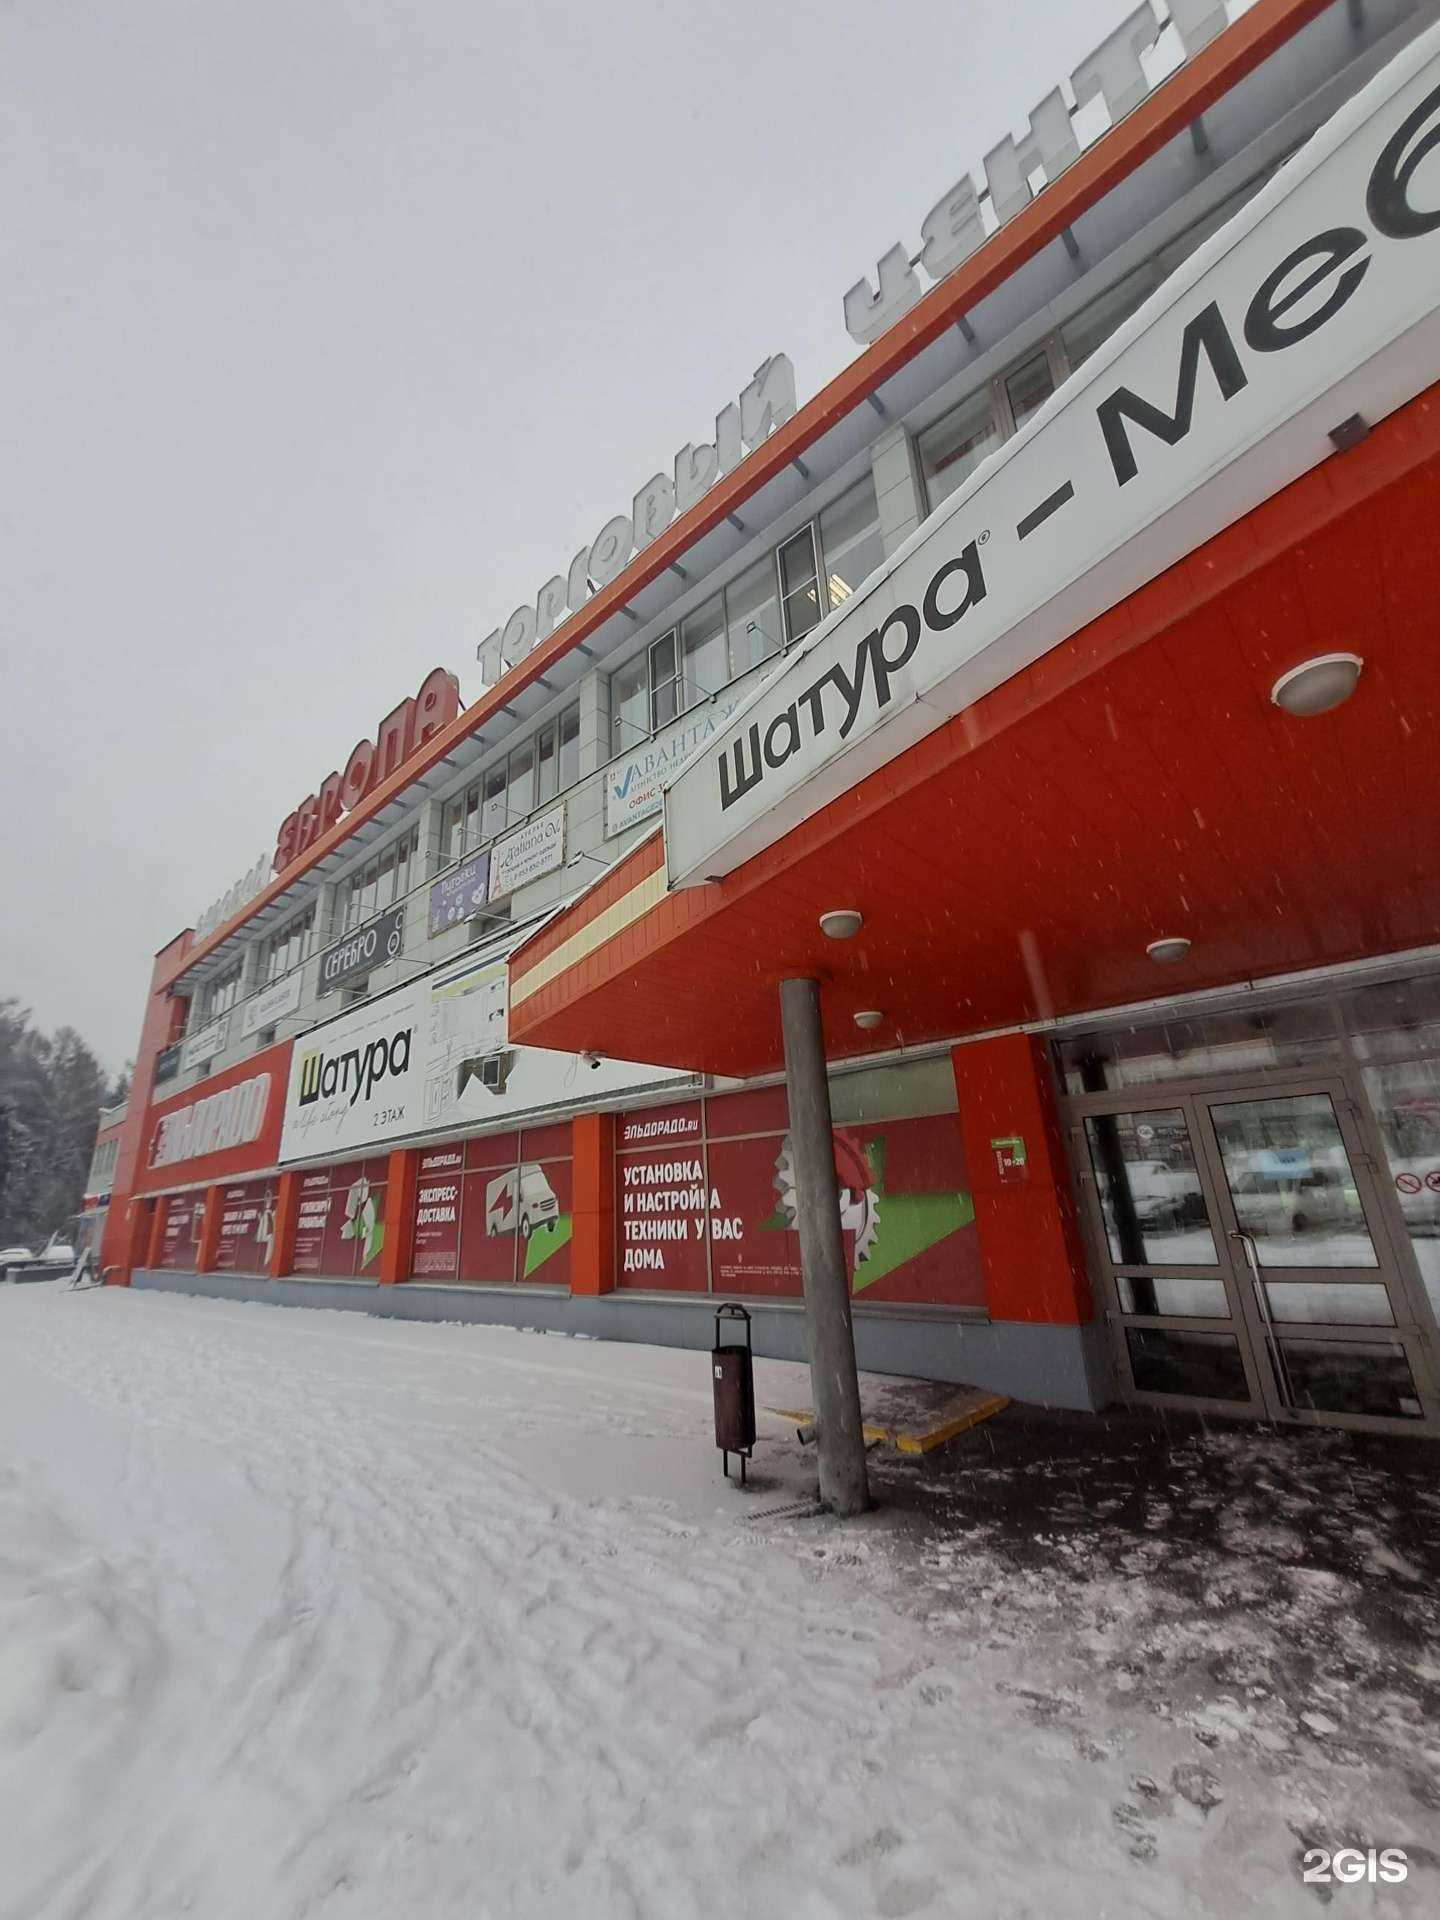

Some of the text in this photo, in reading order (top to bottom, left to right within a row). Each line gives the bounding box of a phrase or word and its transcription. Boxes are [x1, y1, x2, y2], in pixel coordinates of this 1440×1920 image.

[477, 352, 797, 686] ТОРГОВЫЙ
[272, 667, 460, 873] ЕВРОПА
[629, 787, 656, 809] ОФИС
[325, 929, 377, 980] СЕРЕБРО
[298, 1028, 412, 1107] Шатура
[373, 1104, 406, 1127] 2 ЭТАЖ
[623, 1160, 703, 1186] УСТАНОВКА
[624, 1193, 634, 1213] И
[416, 1206, 456, 1226] ДОСТАВКА
[624, 1217, 743, 1241] ТЕХНИКИ У ВАС
[623, 1248, 665, 1273] ДОМА
